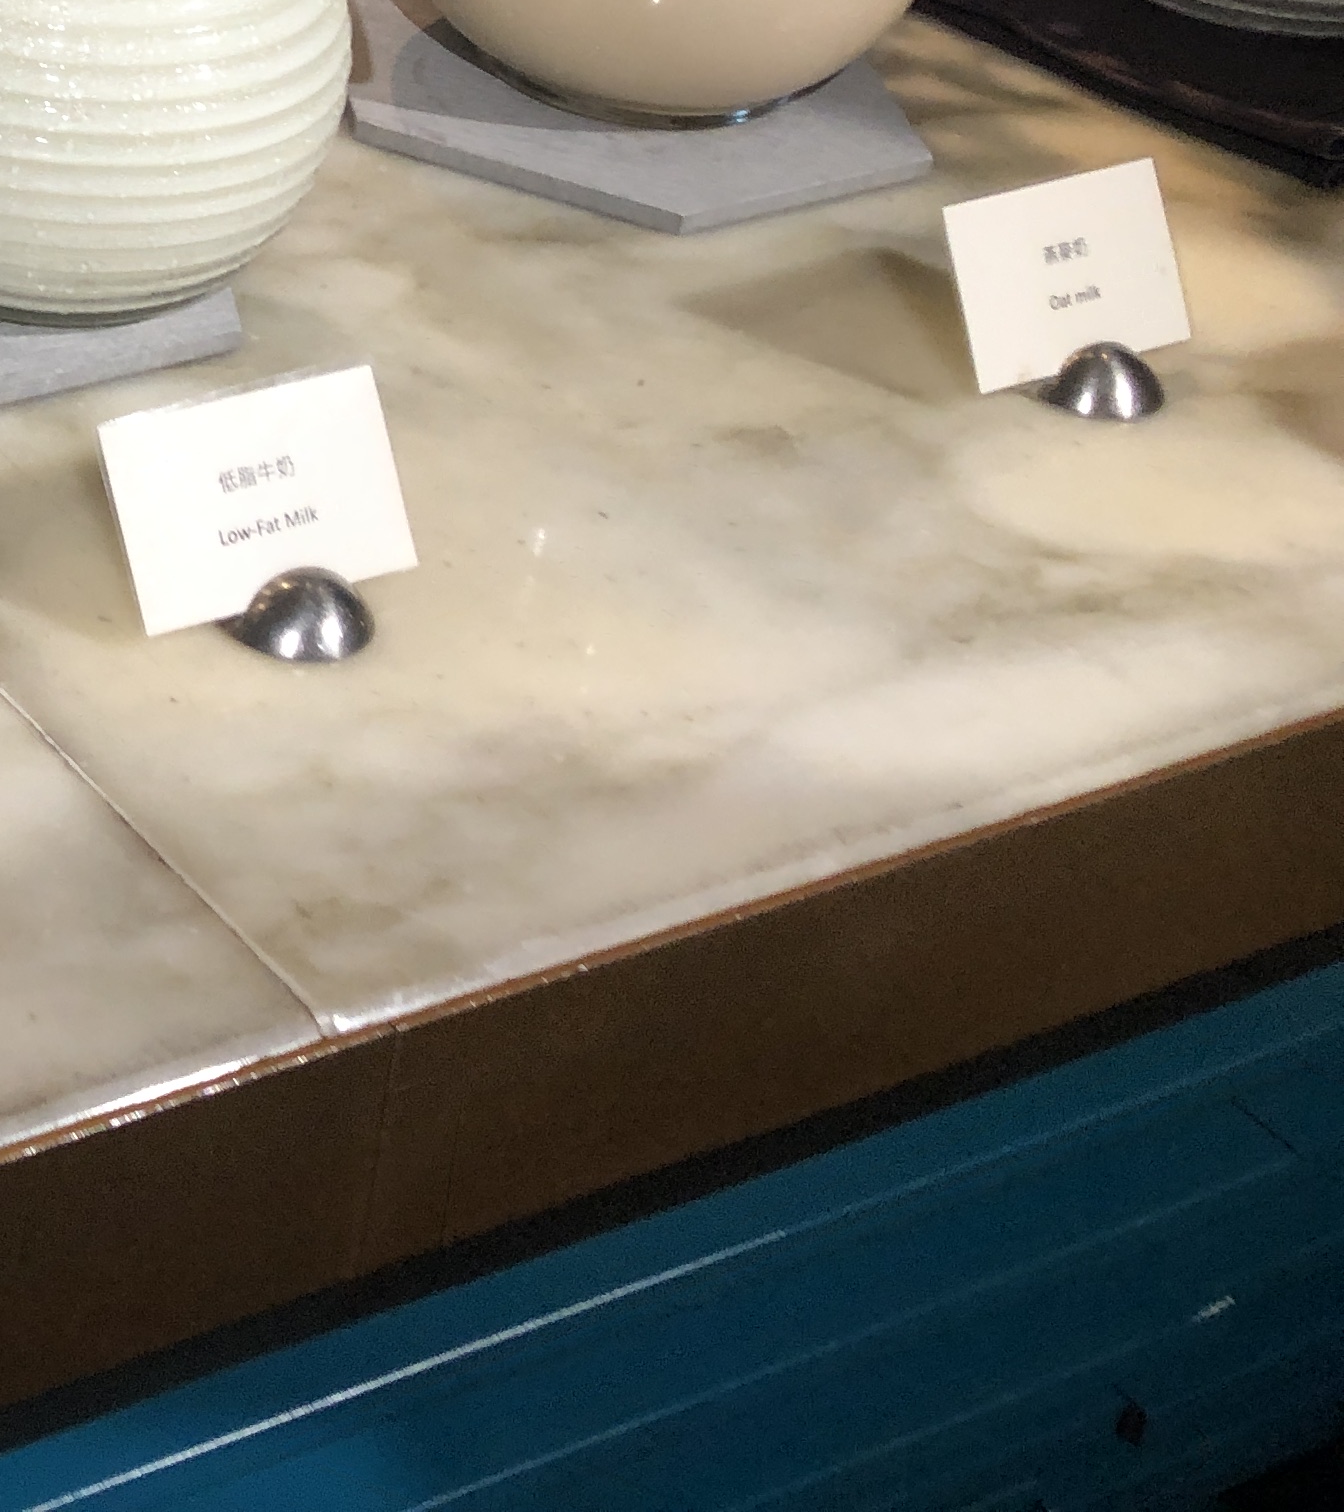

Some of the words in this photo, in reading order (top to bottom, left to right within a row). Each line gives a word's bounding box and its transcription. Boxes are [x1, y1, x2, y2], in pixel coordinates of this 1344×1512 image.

[1049, 292, 1073, 311] Oat
[219, 455, 295, 494] 低脂牛奶
[218, 517, 281, 547] Low-Fat
[284, 506, 319, 528] Milk
